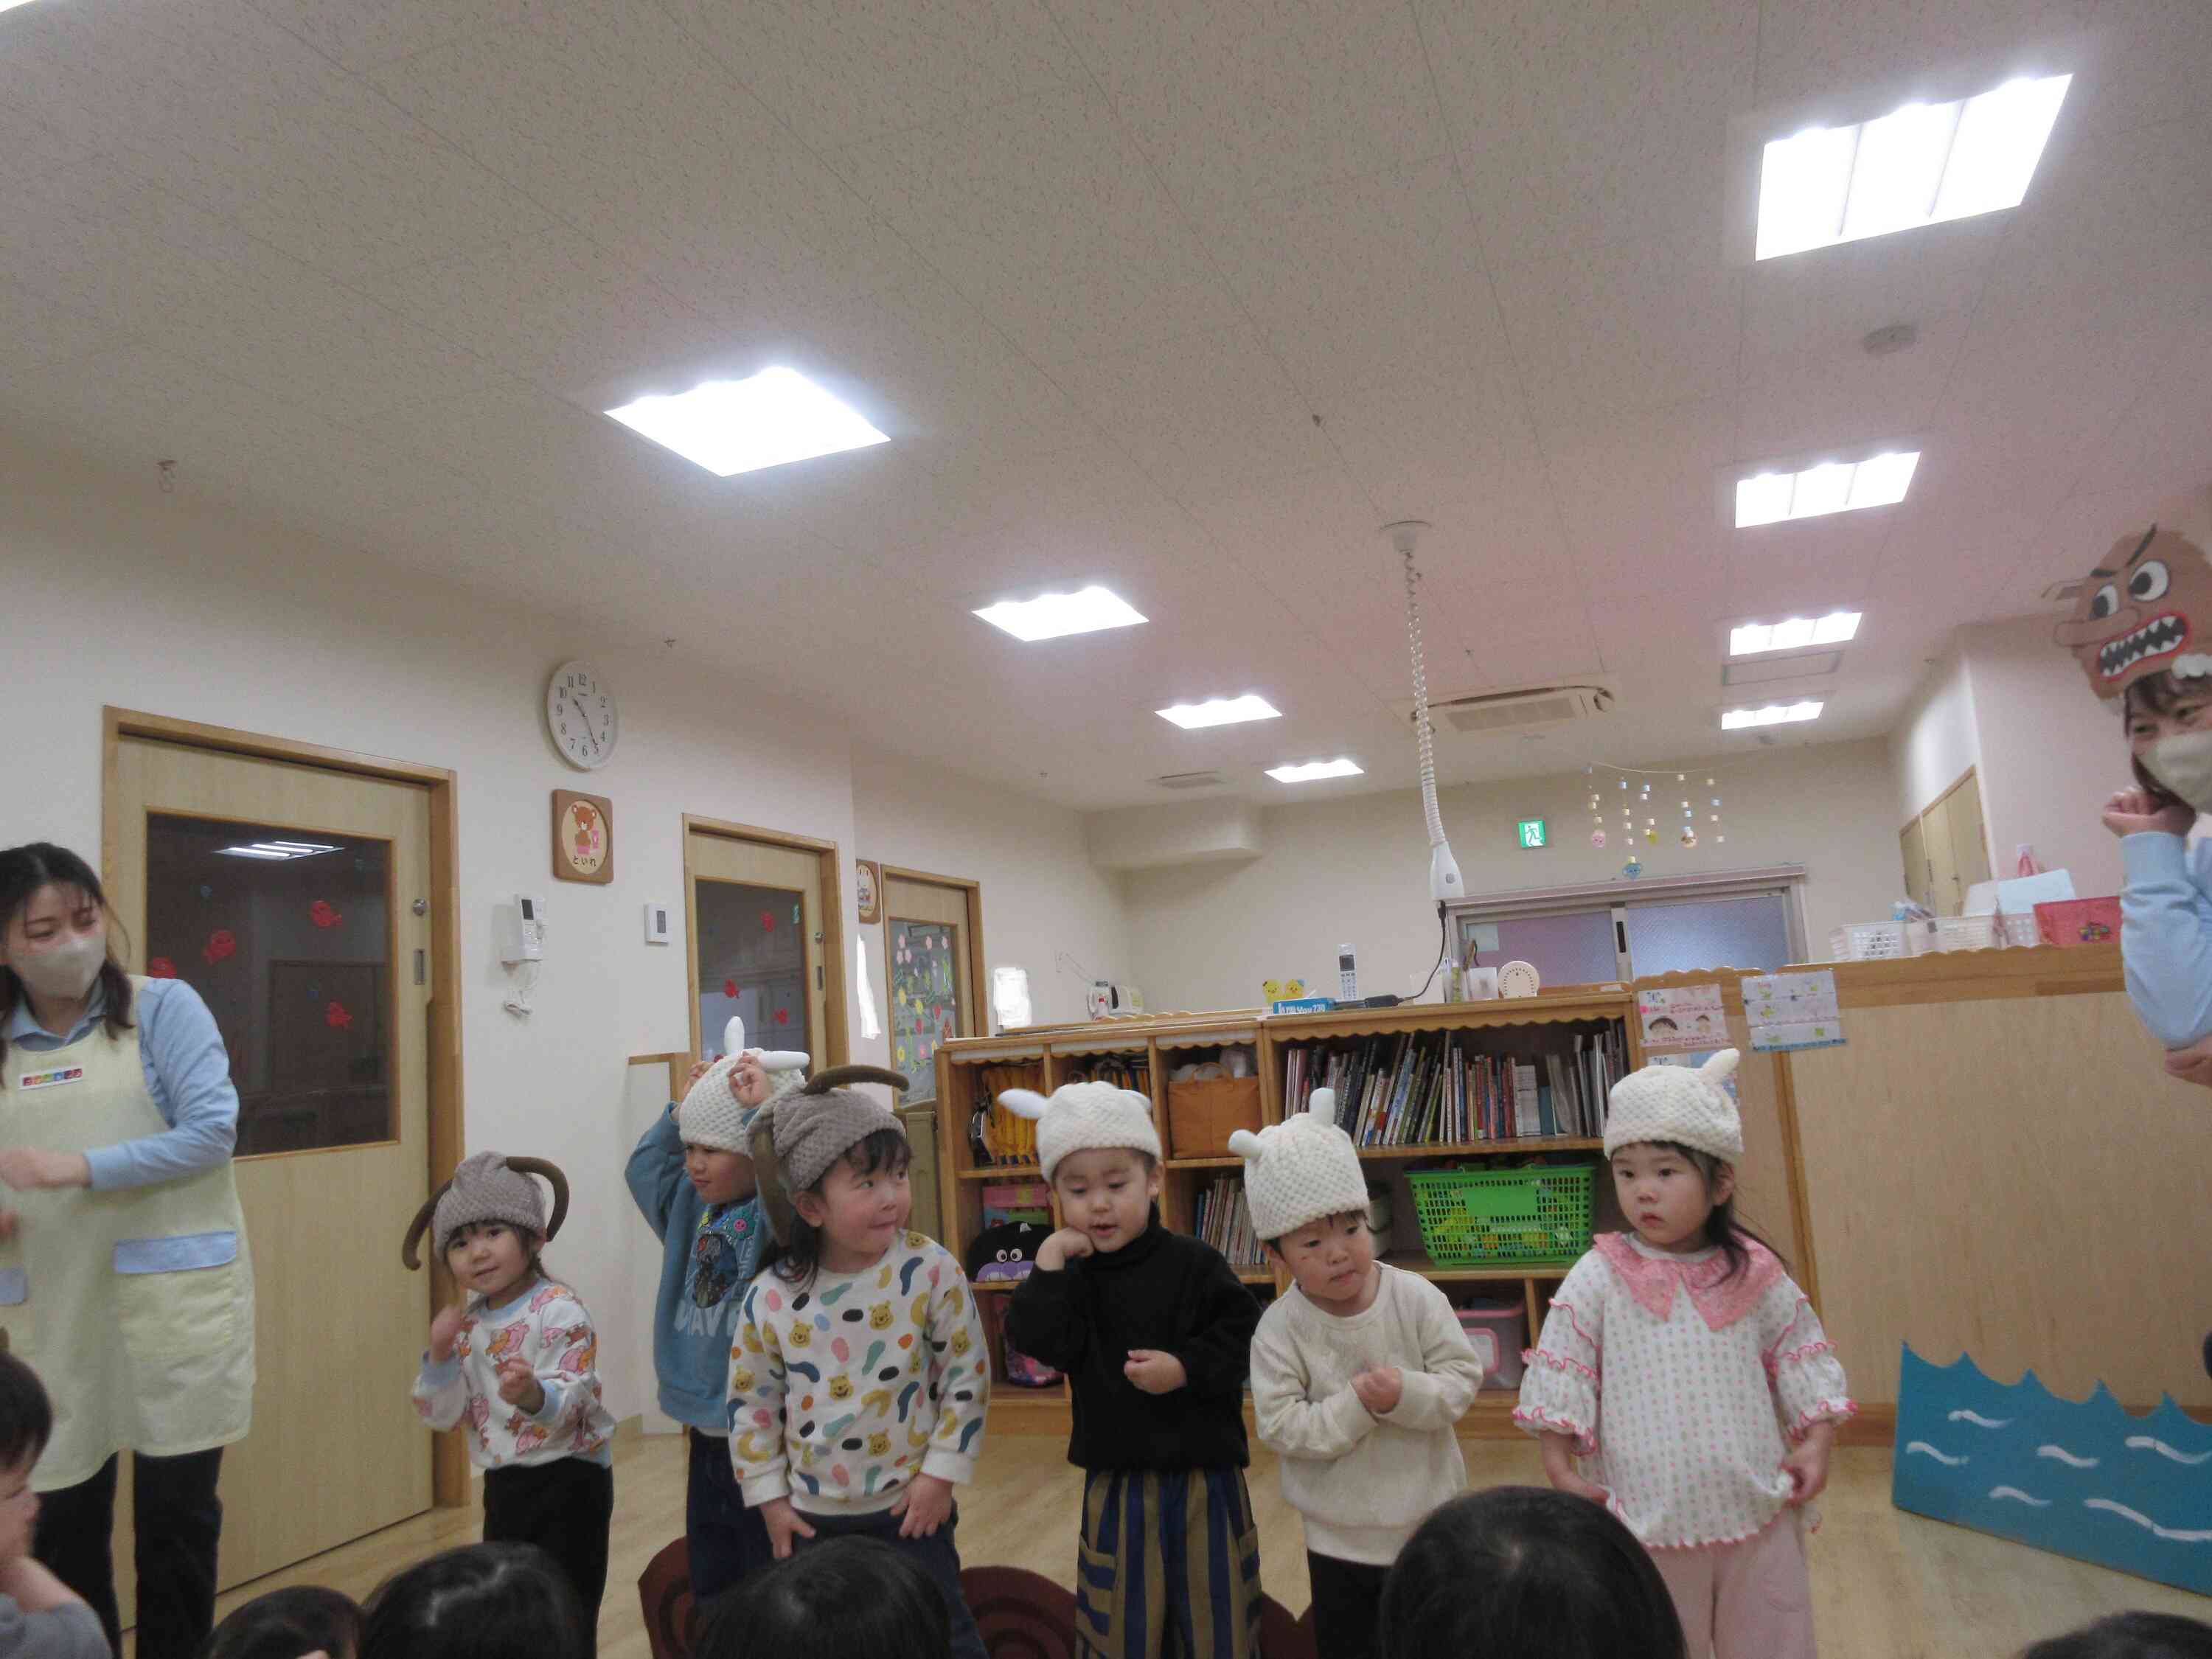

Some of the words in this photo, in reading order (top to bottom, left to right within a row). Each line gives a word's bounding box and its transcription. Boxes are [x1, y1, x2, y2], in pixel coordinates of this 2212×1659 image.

[567, 675, 574, 688] 11
[578, 672, 587, 686] 12
[560, 685, 567, 699] 10
[592, 681, 596, 694] 1
[600, 697, 608, 709] 2
[556, 704, 563, 715] 9
[603, 714, 610, 726] 3
[560, 723, 567, 735] 8
[601, 731, 608, 742] 4
[570, 737, 577, 751] 7
[594, 743, 599, 755] 5
[582, 745, 588, 757] 6
[573, 855, 597, 867] といれ
